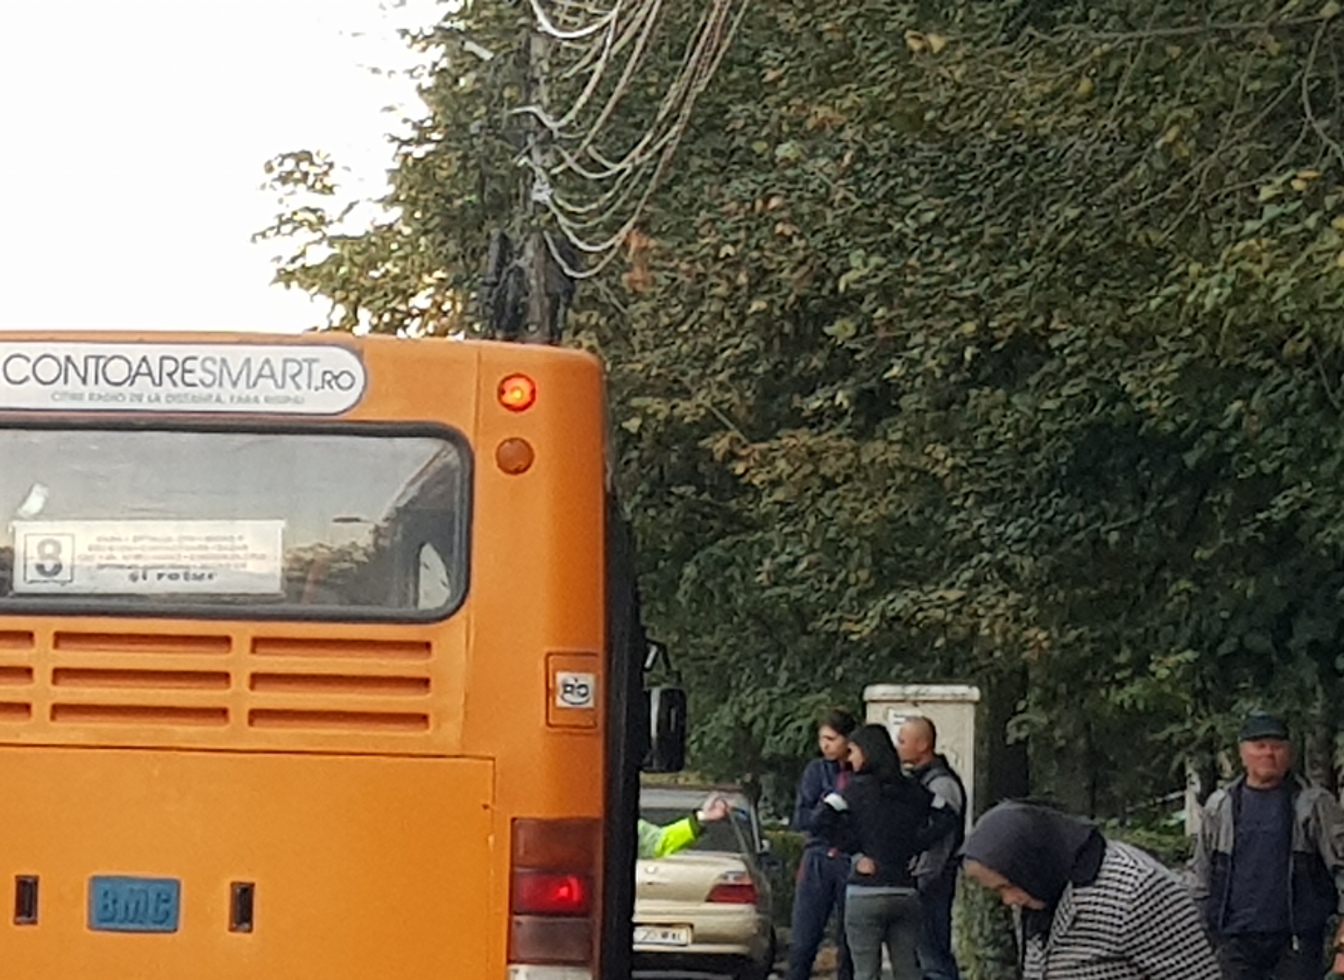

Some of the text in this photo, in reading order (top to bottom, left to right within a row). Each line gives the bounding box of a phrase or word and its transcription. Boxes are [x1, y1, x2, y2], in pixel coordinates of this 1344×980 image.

[2, 352, 356, 392] CONTOARESMART.RO
[35, 538, 63, 578] 8
[98, 883, 172, 925] BMC
